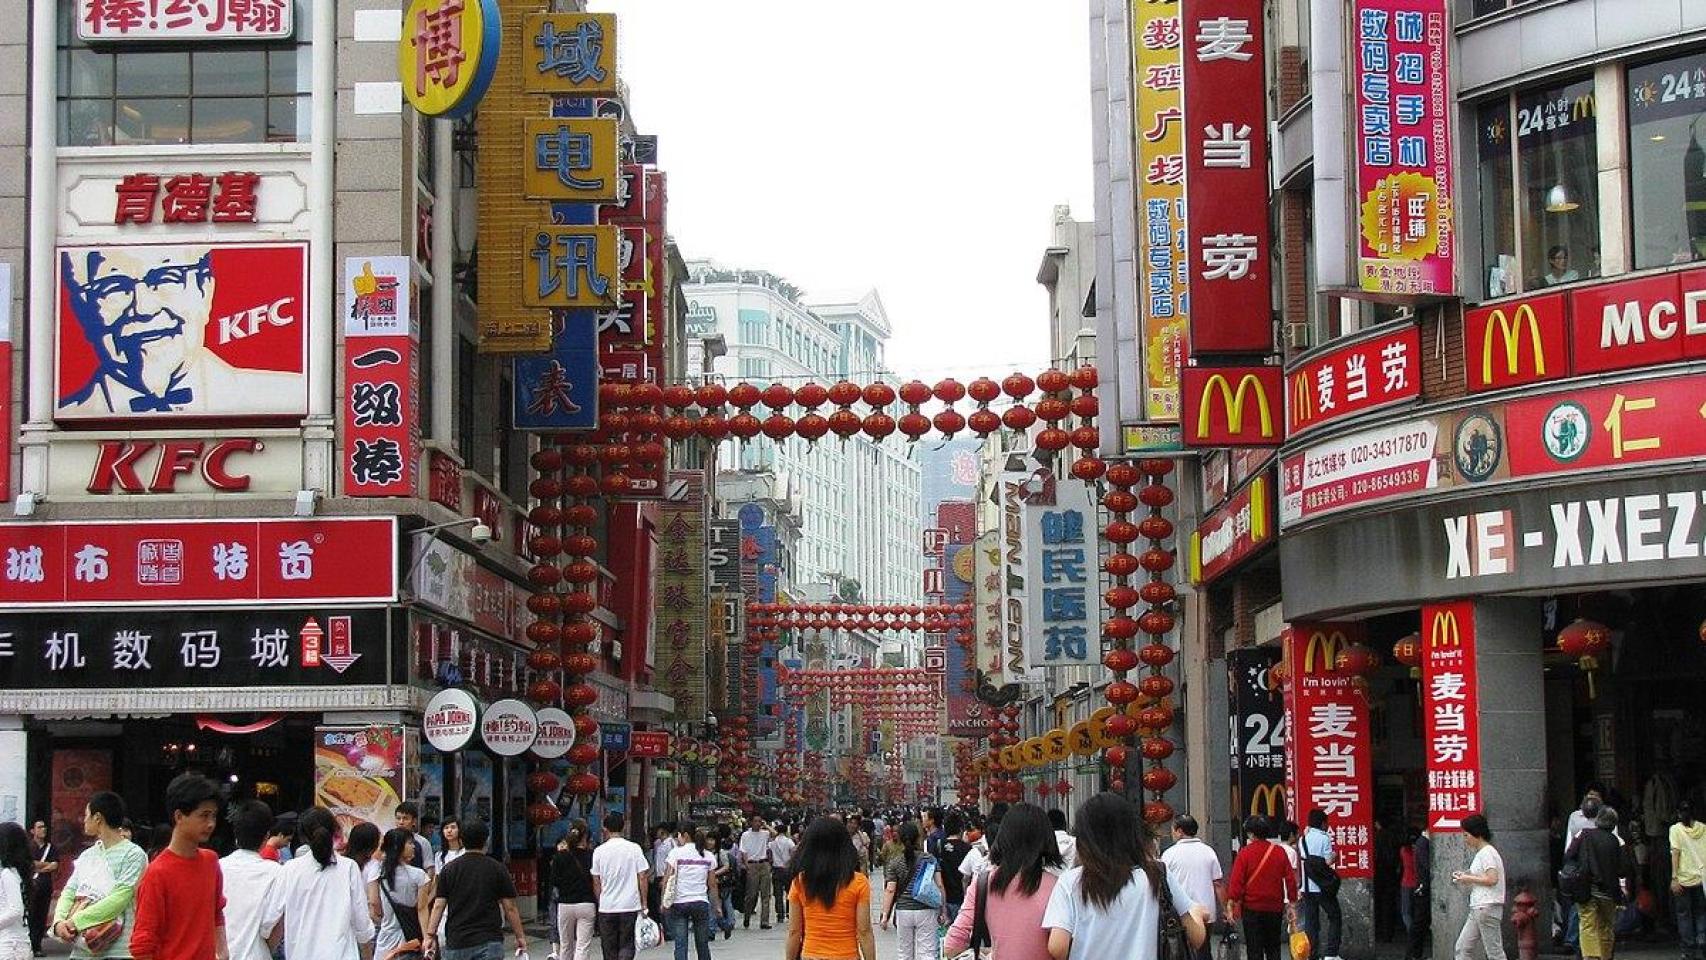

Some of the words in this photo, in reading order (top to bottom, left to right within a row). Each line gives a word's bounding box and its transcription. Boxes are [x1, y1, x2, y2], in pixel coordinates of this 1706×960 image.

[84, 0, 284, 34] 棒!约翰
[1360, 9, 1392, 166] 数码专卖店
[1395, 10, 1426, 167] 诚招手机
[1545, 98, 1569, 115] 小时
[1661, 71, 1691, 103] 24
[1195, 17, 1258, 280] 麦当劳
[1518, 105, 1543, 137] 24
[1546, 114, 1570, 130] 营业
[529, 17, 609, 299] 域电讯
[114, 171, 261, 225] 肯德基
[1148, 199, 1175, 318] 数码专卖店
[219, 297, 294, 345] KFC
[1600, 289, 1706, 349] McD
[1317, 341, 1409, 413] 麦当劳
[351, 348, 403, 487] 一级棒
[1603, 393, 1661, 459] 仁
[86, 439, 252, 495] KFC
[1350, 431, 1428, 466] 020-34317870
[7, 544, 109, 583] 城市
[213, 541, 314, 582] 特首
[709, 526, 729, 587] TSL
[1040, 509, 1088, 661] 健民医药
[949, 719, 993, 728] ANCHO
[1430, 672, 1468, 763] 麦当劳
[1308, 702, 1359, 818] 麦当劳
